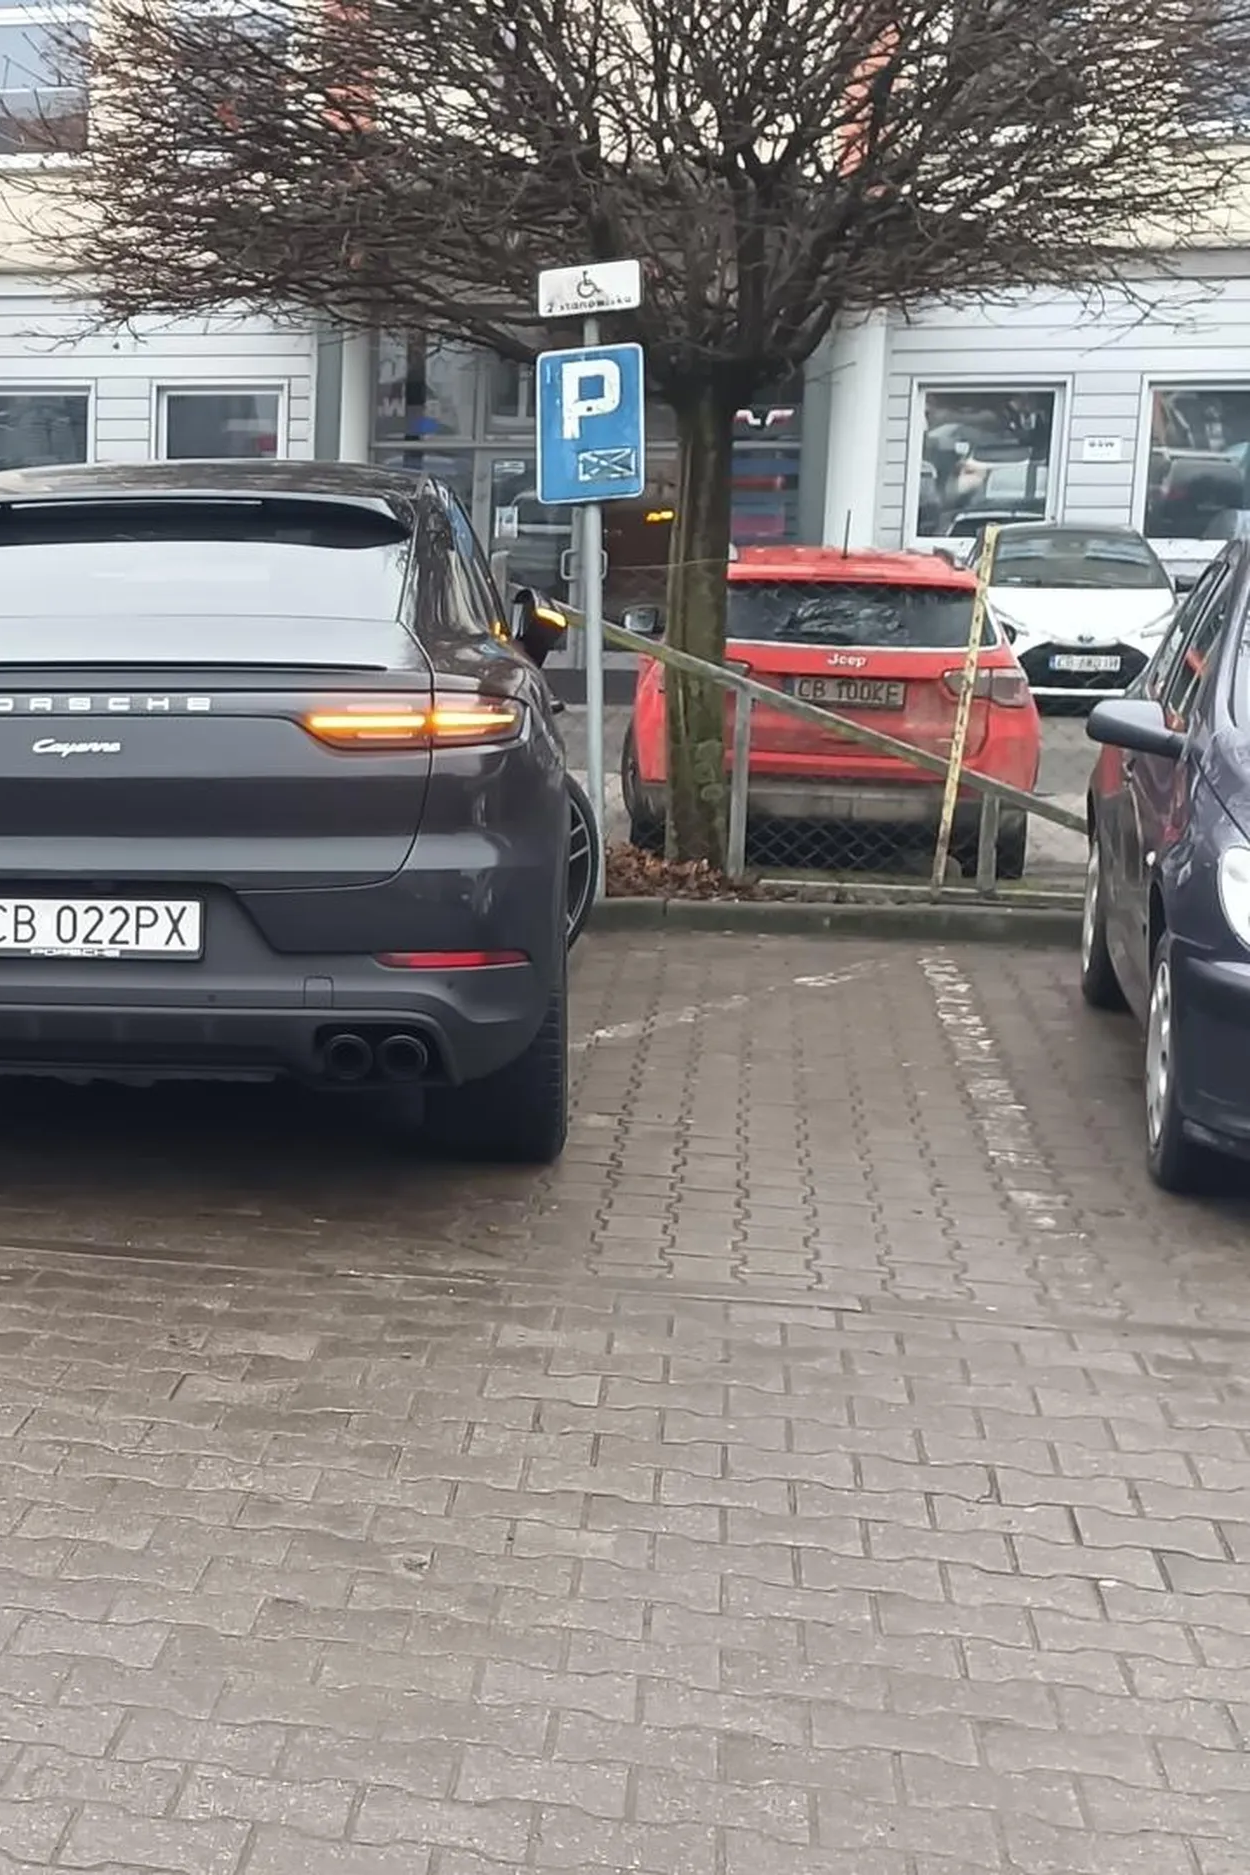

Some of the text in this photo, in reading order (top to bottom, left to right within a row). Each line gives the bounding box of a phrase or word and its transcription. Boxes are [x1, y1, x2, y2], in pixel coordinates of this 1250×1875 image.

[562, 359, 620, 440] P
[827, 653, 867, 667] Jeep
[799, 679, 826, 697] CB
[32, 738, 121, 757] Cayenne
[56, 905, 187, 945] 022PX
